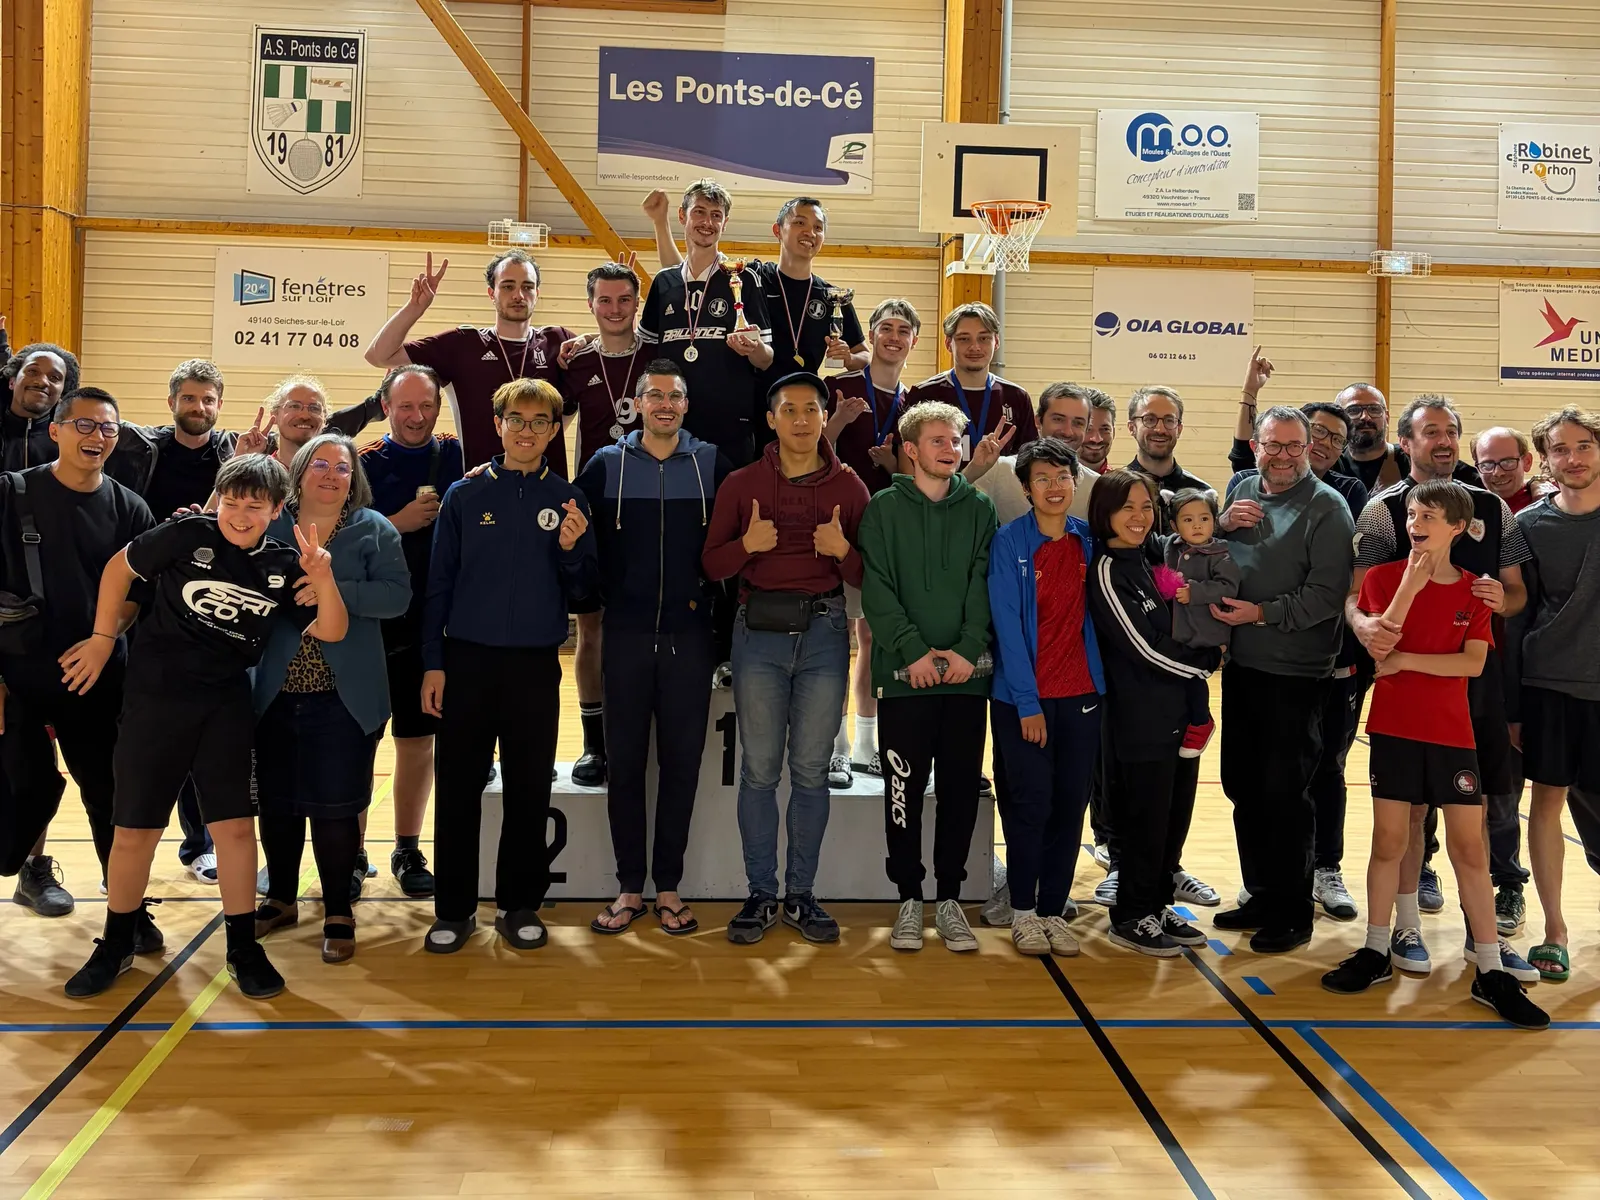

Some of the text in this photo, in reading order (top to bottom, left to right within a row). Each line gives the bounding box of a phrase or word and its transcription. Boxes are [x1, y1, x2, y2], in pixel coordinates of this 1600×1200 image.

[264, 38, 356, 59] A.S. Ponts de Cé
[610, 73, 862, 109] Les Ponts-de-Cé
[267, 132, 344, 166] 19 81
[1126, 159, 1230, 187] Concepteur d'innovation
[244, 283, 257, 294] 20
[309, 294, 334, 303] Loir
[274, 317, 345, 326] Seiches-sur-le-Loir
[1126, 319, 1162, 333] OIA
[1167, 320, 1248, 336] GLOBAL
[234, 331, 359, 348] 02 41 77 04 08
[615, 397, 637, 424] 9
[715, 712, 736, 786] 1
[892, 774, 907, 828] asics
